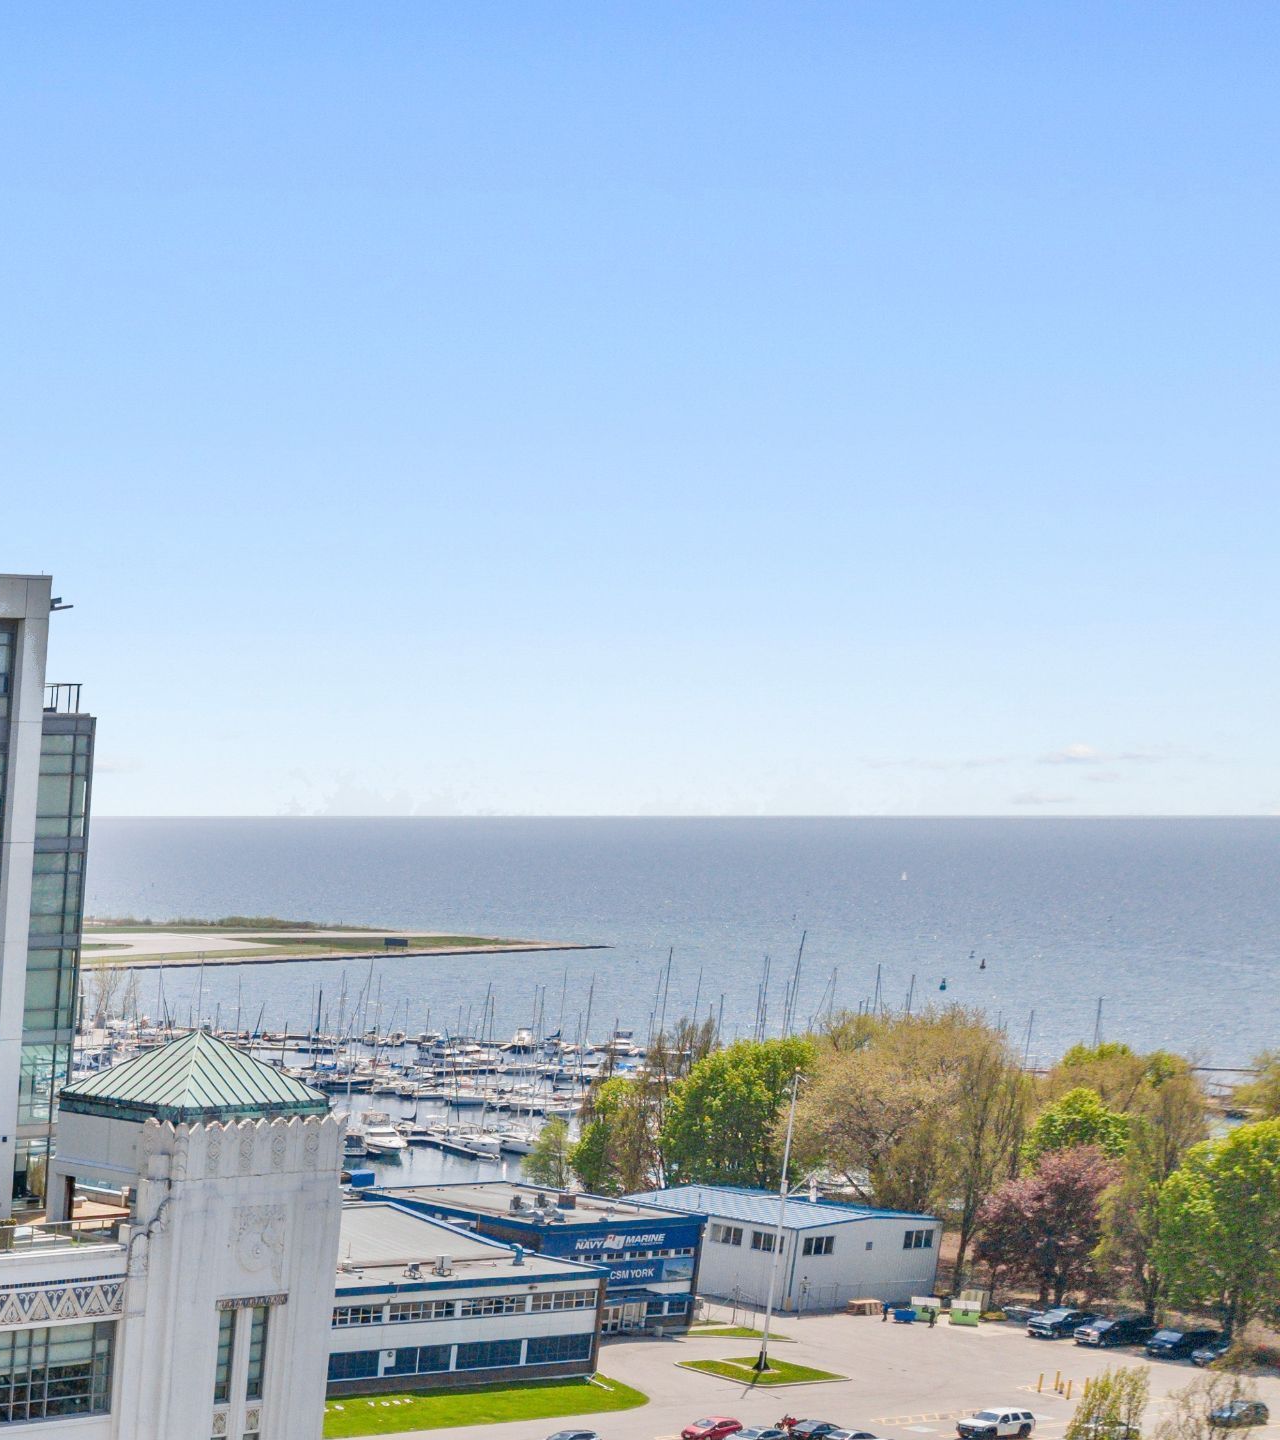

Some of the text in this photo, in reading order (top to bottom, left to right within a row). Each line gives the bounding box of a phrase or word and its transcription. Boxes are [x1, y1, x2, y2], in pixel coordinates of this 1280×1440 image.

[575, 1240, 603, 1250] NAVY
[626, 1233, 666, 1244] MARINE
[630, 1268, 655, 1279] YORK
